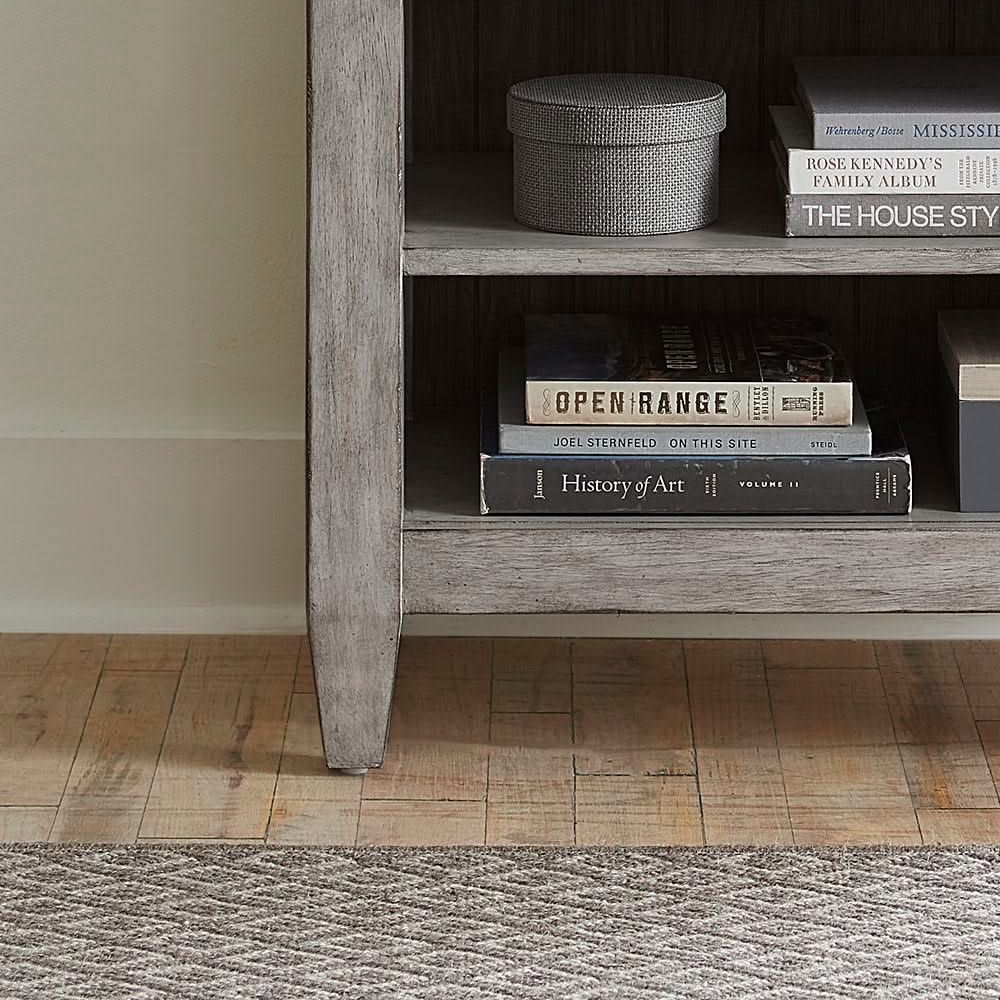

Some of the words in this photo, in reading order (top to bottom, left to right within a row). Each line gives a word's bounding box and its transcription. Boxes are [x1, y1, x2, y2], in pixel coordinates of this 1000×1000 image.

[806, 158, 846, 170] ROSE
[850, 158, 943, 170] KENNEDY'S
[813, 176, 874, 188] FAMILY
[878, 176, 936, 188] ALBUM
[802, 206, 852, 228] THE
[856, 205, 944, 228] HOUSE
[555, 391, 625, 415] OPEN
[638, 390, 729, 415] RANGE
[554, 437, 584, 448] JOEL
[586, 437, 658, 448] STERNFELD
[669, 438, 689, 448] ON
[692, 438, 723, 448] THIS
[728, 438, 758, 449] SITE
[534, 469, 546, 500] Janson
[562, 474, 632, 499] History
[635, 476, 652, 498] of
[653, 474, 686, 492] Art
